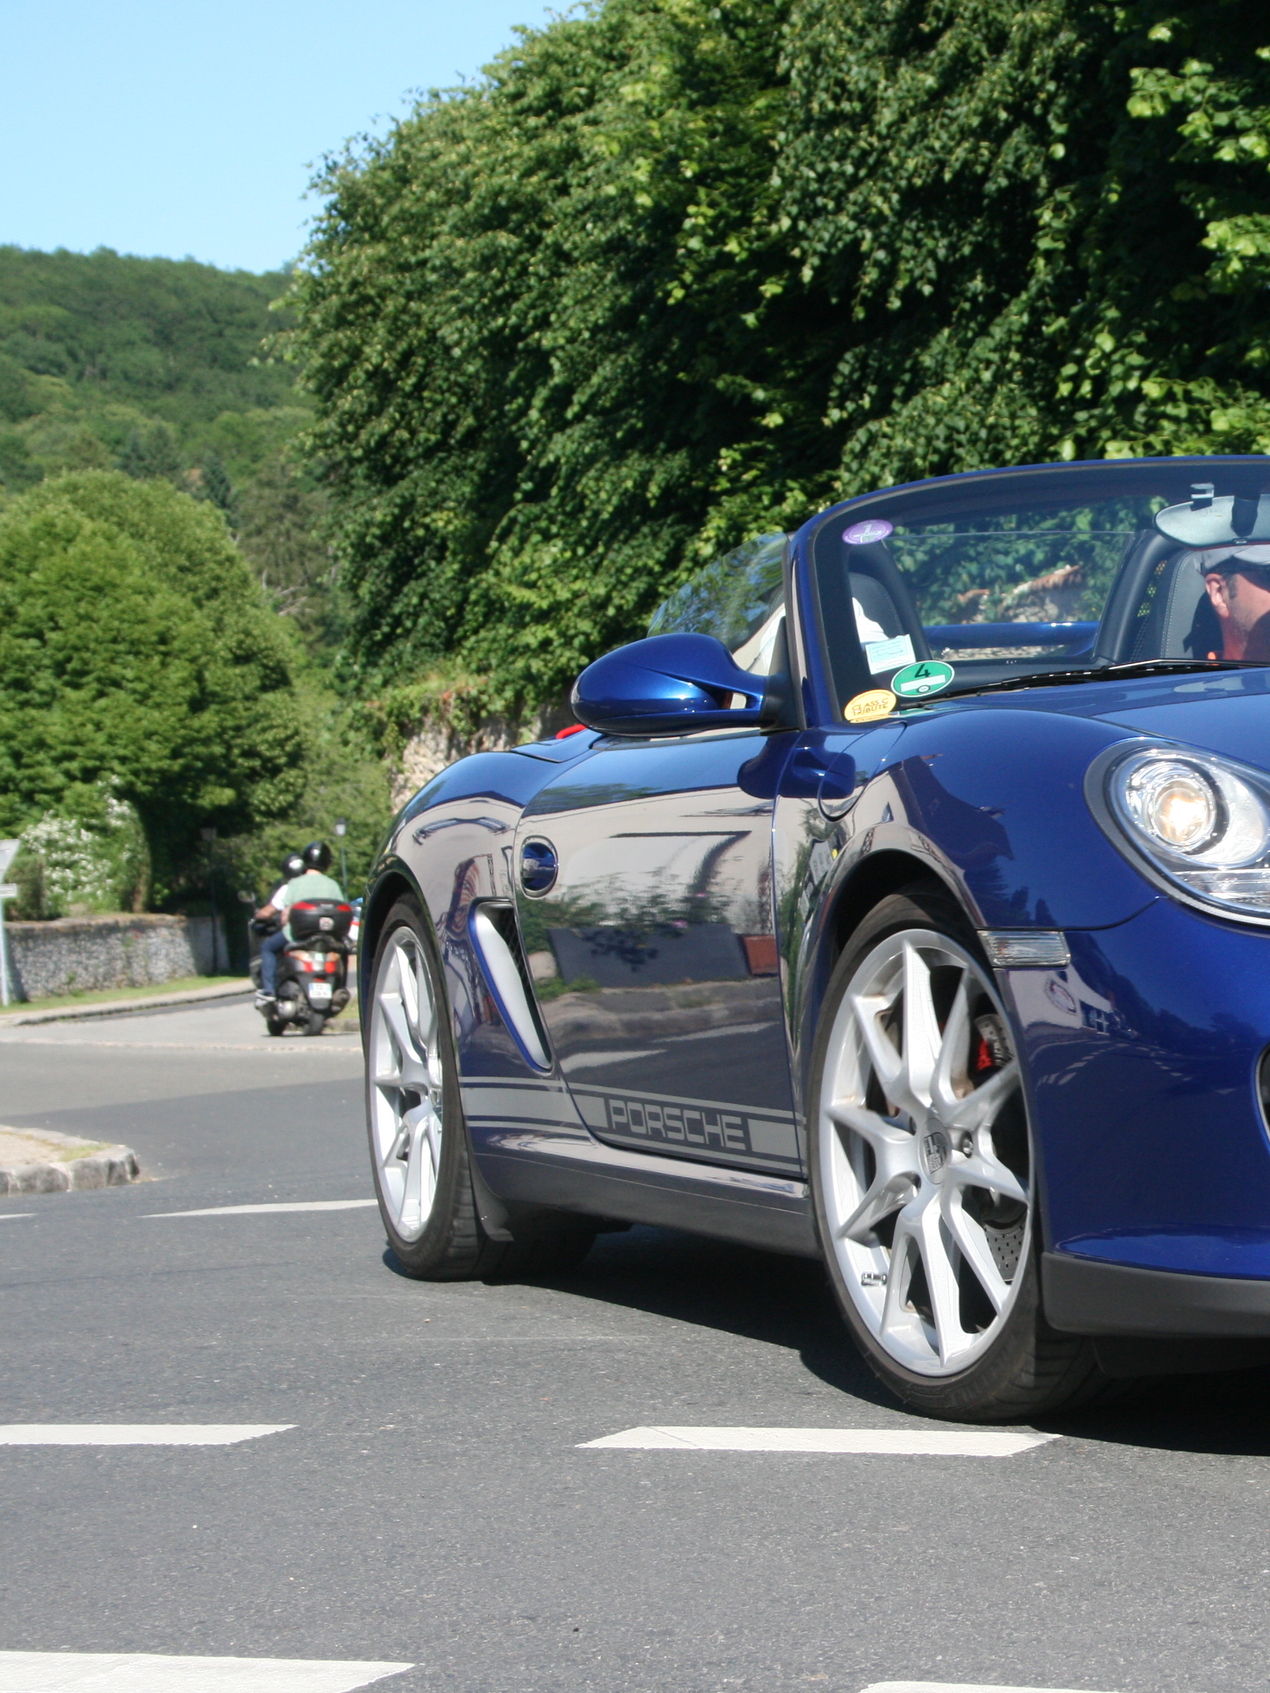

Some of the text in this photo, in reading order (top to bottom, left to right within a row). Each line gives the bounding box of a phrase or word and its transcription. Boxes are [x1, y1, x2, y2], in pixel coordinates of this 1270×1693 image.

[914, 664, 931, 678] 4
[851, 698, 889, 711] CLASSC
[852, 704, 888, 716] TRIBUTE
[609, 1099, 746, 1150] PORSCHE
